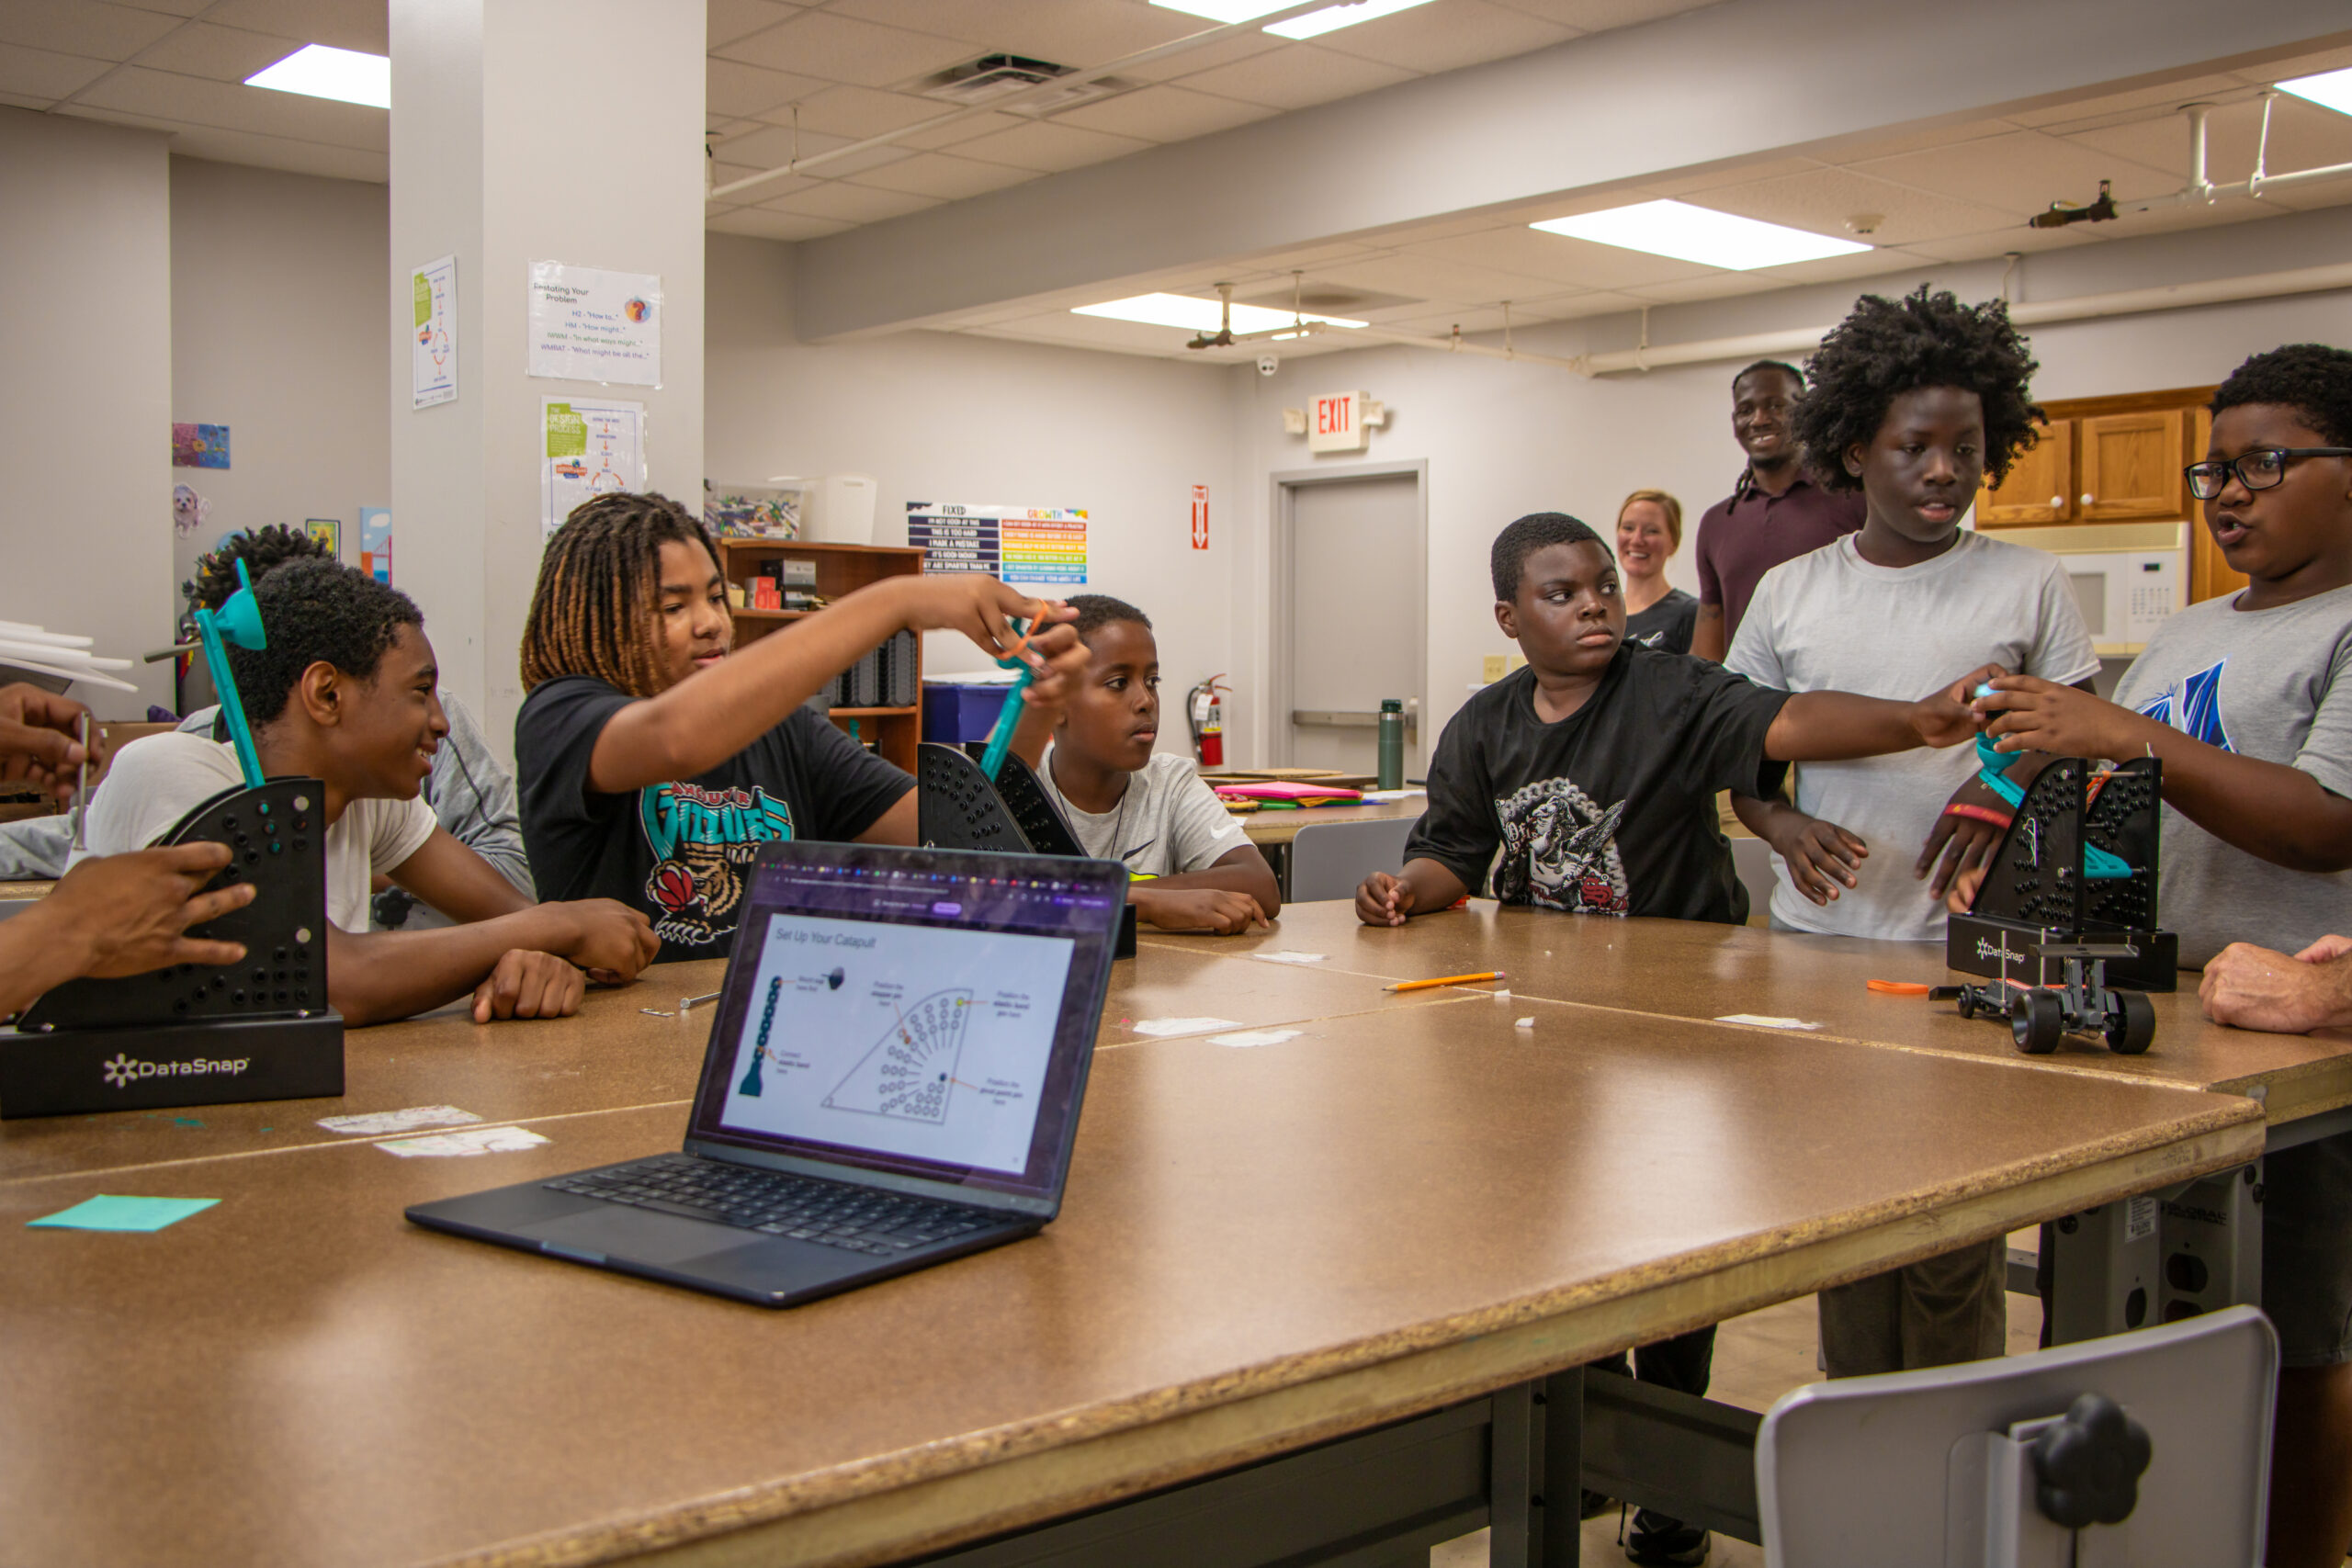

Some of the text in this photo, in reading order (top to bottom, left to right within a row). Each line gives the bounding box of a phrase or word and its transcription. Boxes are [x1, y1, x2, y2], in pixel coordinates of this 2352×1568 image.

[571, 287, 589, 296] Your
[546, 293, 577, 304] Problem
[583, 335, 599, 344] what
[549, 413, 580, 424] DESIGN
[1318, 397, 1351, 434] EXIT
[943, 505, 967, 515] FIXED
[1028, 509, 1062, 519] GROWTH
[932, 528, 943, 536] THIS
[963, 529, 978, 537] HARD
[933, 539, 948, 547] MADE
[955, 540, 979, 548] MISTAKE
[932, 561, 944, 570] ARE
[944, 562, 968, 570] SMARTER
[776, 928, 876, 949] Set Up Your Catapult
